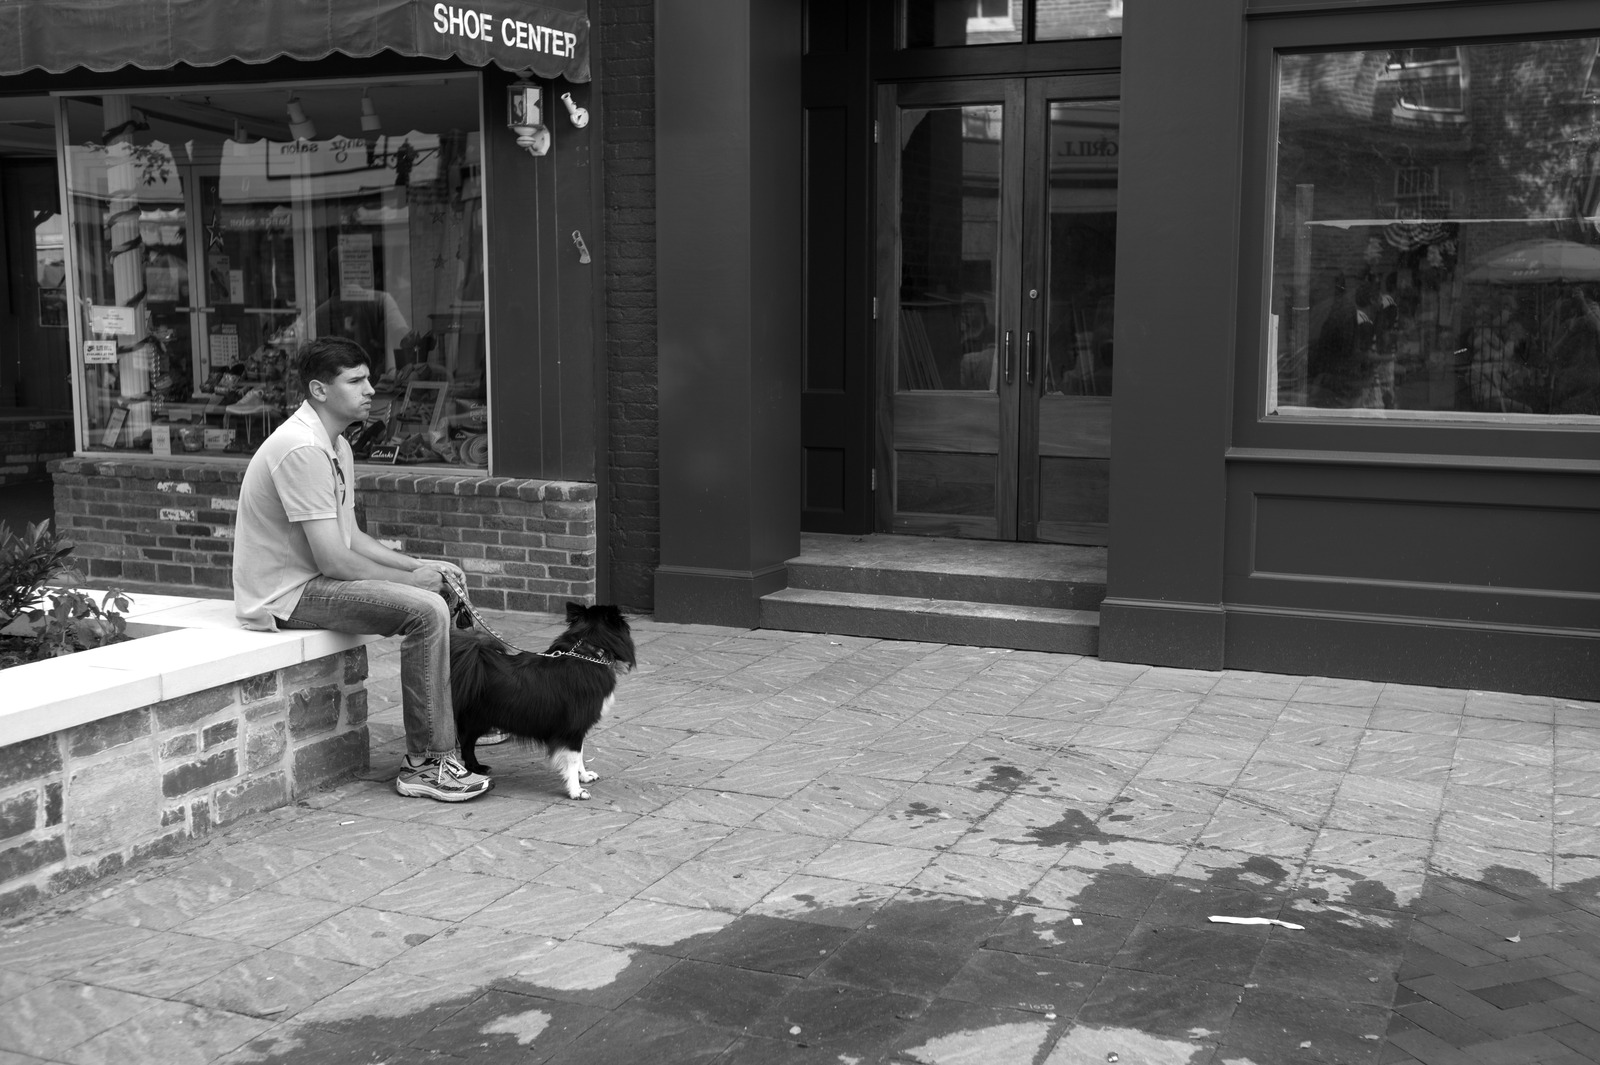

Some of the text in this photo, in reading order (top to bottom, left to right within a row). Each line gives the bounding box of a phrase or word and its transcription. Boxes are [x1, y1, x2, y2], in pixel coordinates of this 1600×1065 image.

[433, 2, 577, 59] SHOE CENTER
[371, 450, 394, 459] Clarks
